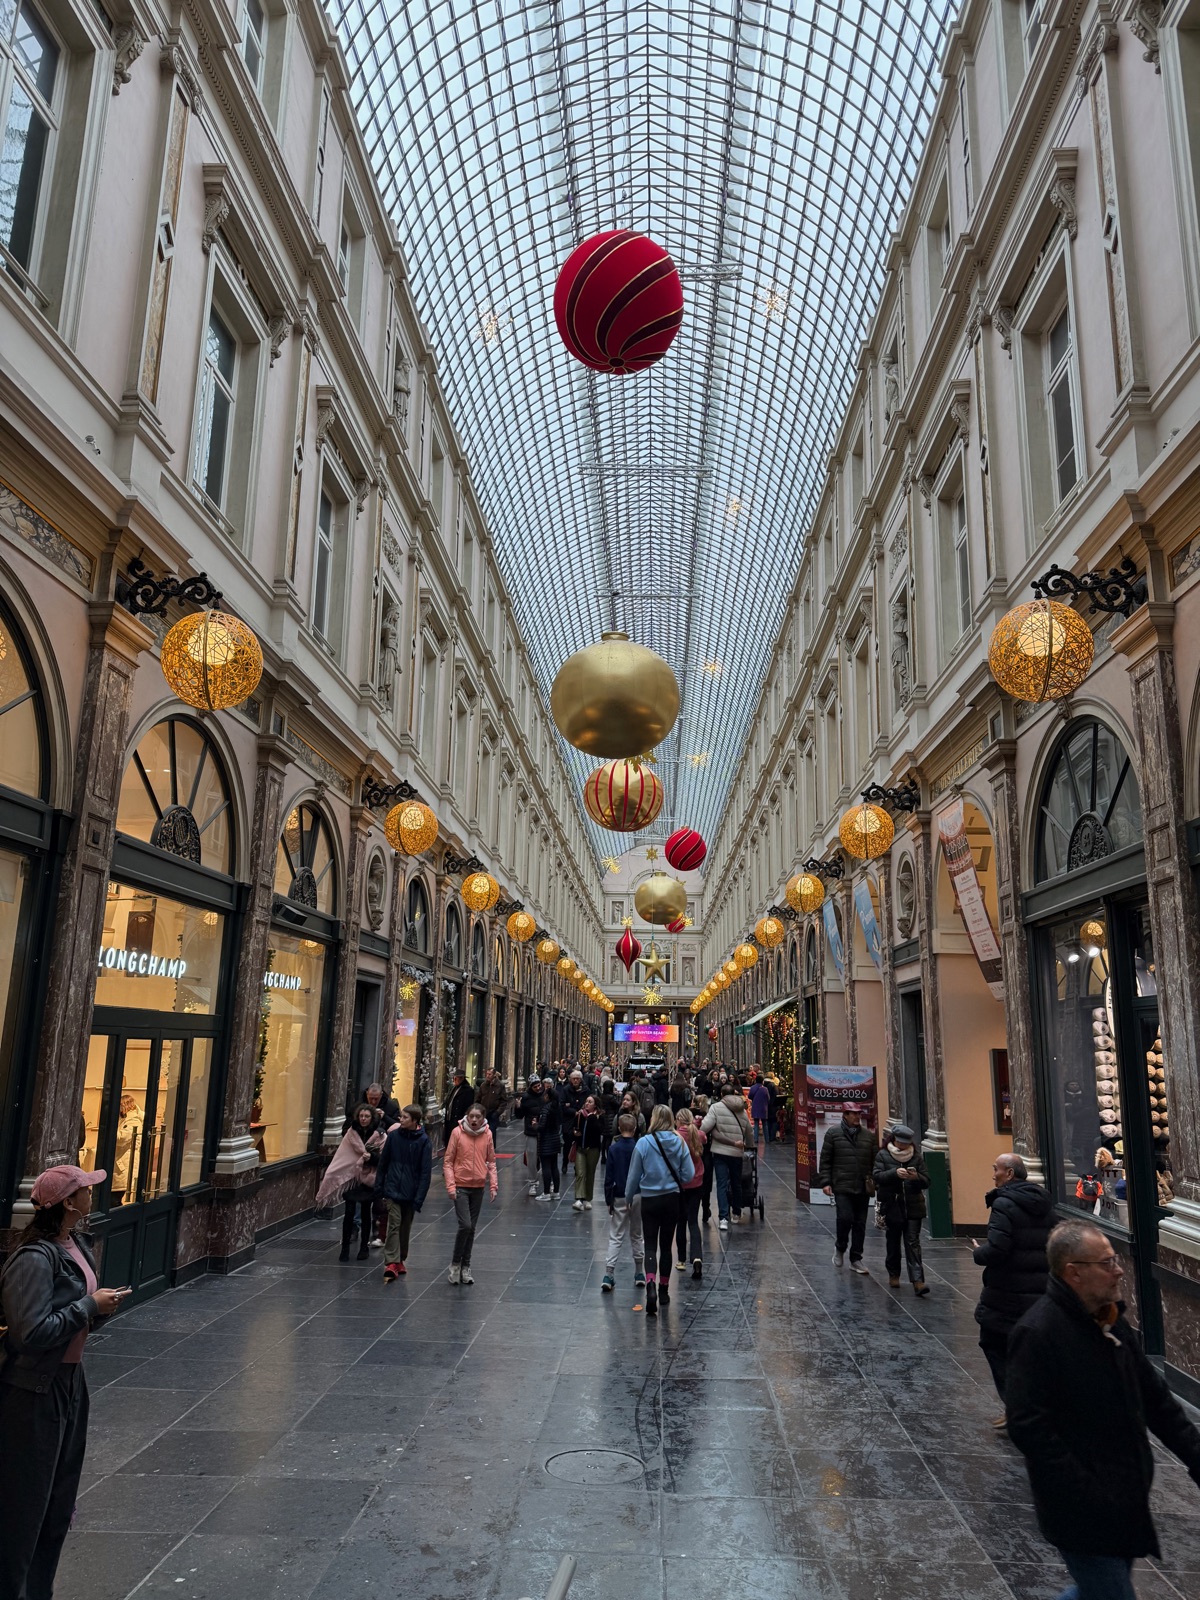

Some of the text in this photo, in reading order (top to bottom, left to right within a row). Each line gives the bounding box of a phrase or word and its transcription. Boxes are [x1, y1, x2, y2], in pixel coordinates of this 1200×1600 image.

[98, 945, 187, 978] LONGCHAMP
[827, 1077, 853, 1085] SAISON
[813, 1088, 868, 1099] 2025-2026
